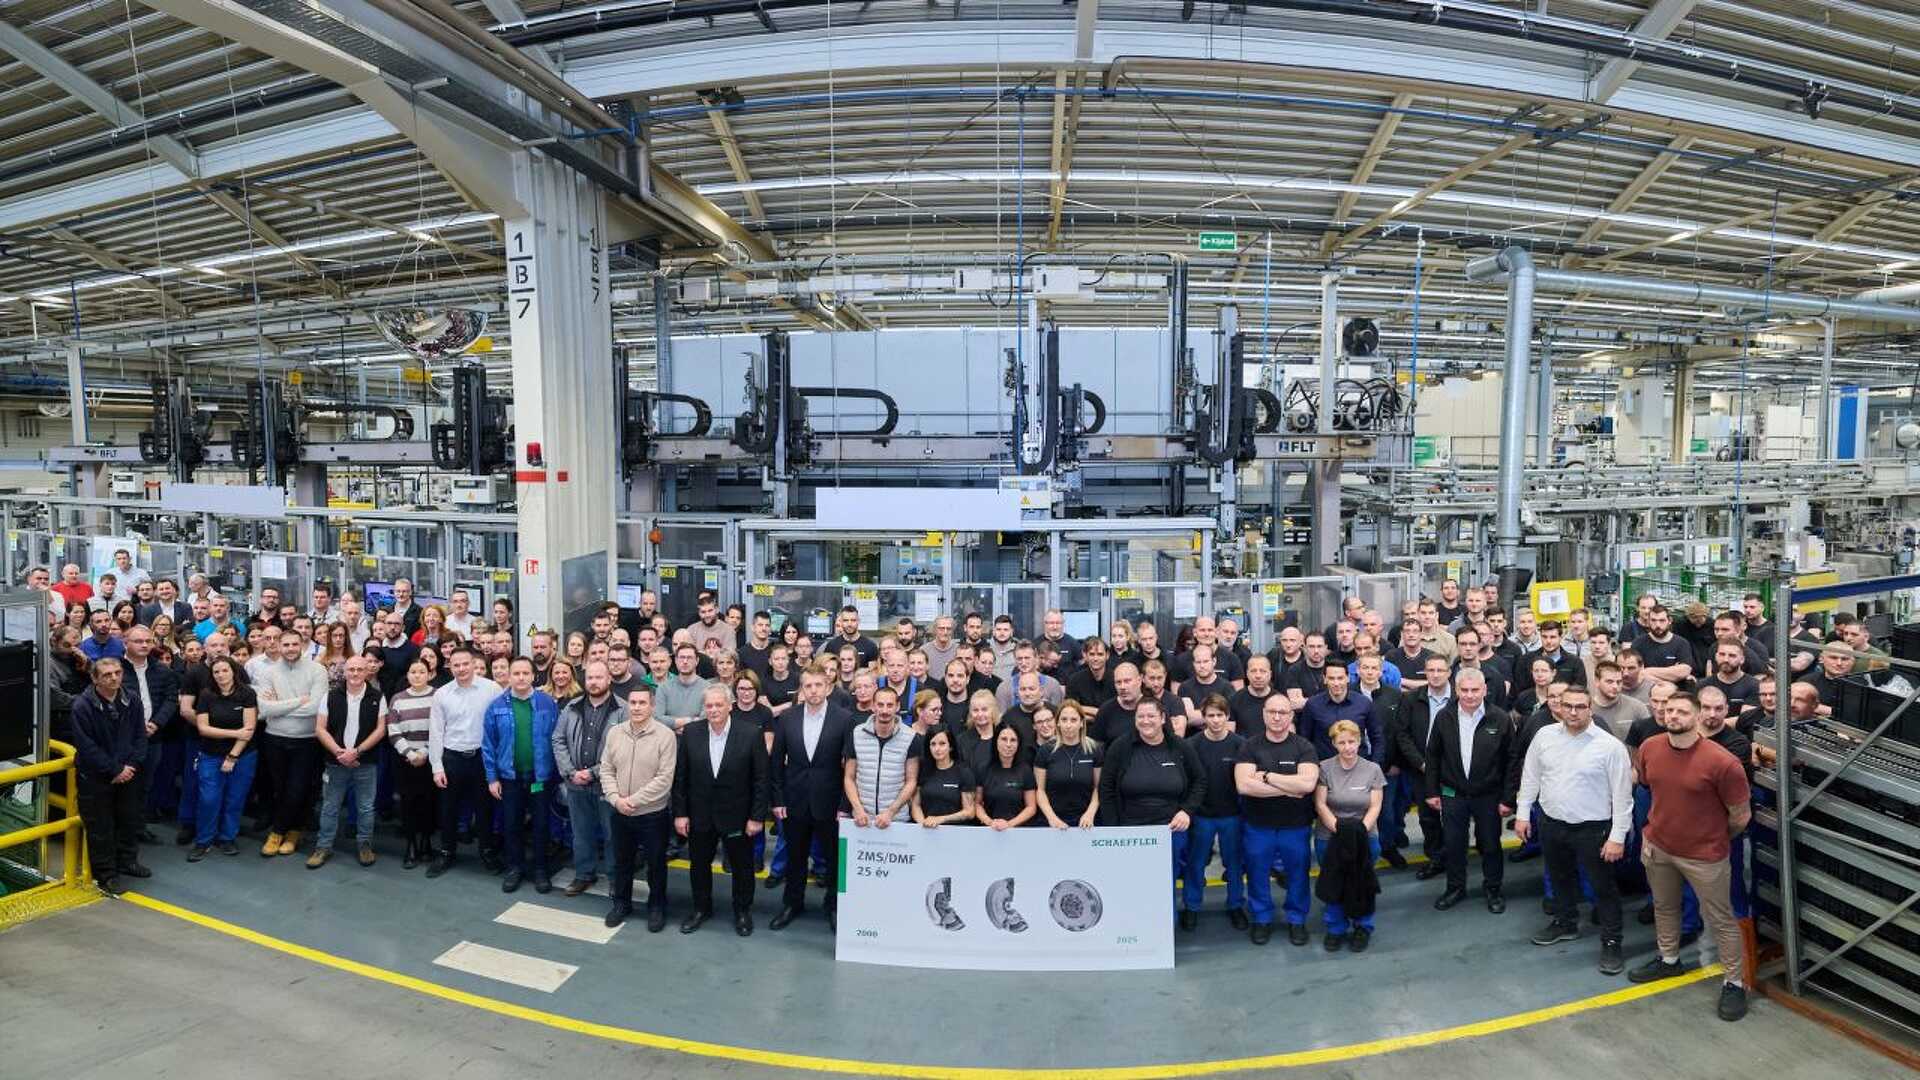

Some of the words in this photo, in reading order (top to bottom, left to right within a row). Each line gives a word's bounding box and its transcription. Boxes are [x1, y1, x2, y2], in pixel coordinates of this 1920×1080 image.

[514, 232, 523, 252] 1
[592, 256, 600, 273] B
[515, 264, 529, 284] B
[593, 287, 599, 304] 7
[516, 298, 530, 319] 7
[1291, 441, 1316, 452] FLT
[1091, 838, 1157, 847] SCHAEFFLER
[856, 850, 916, 864] ZMS/DMF
[856, 866, 872, 876] 25
[875, 867, 889, 877] év
